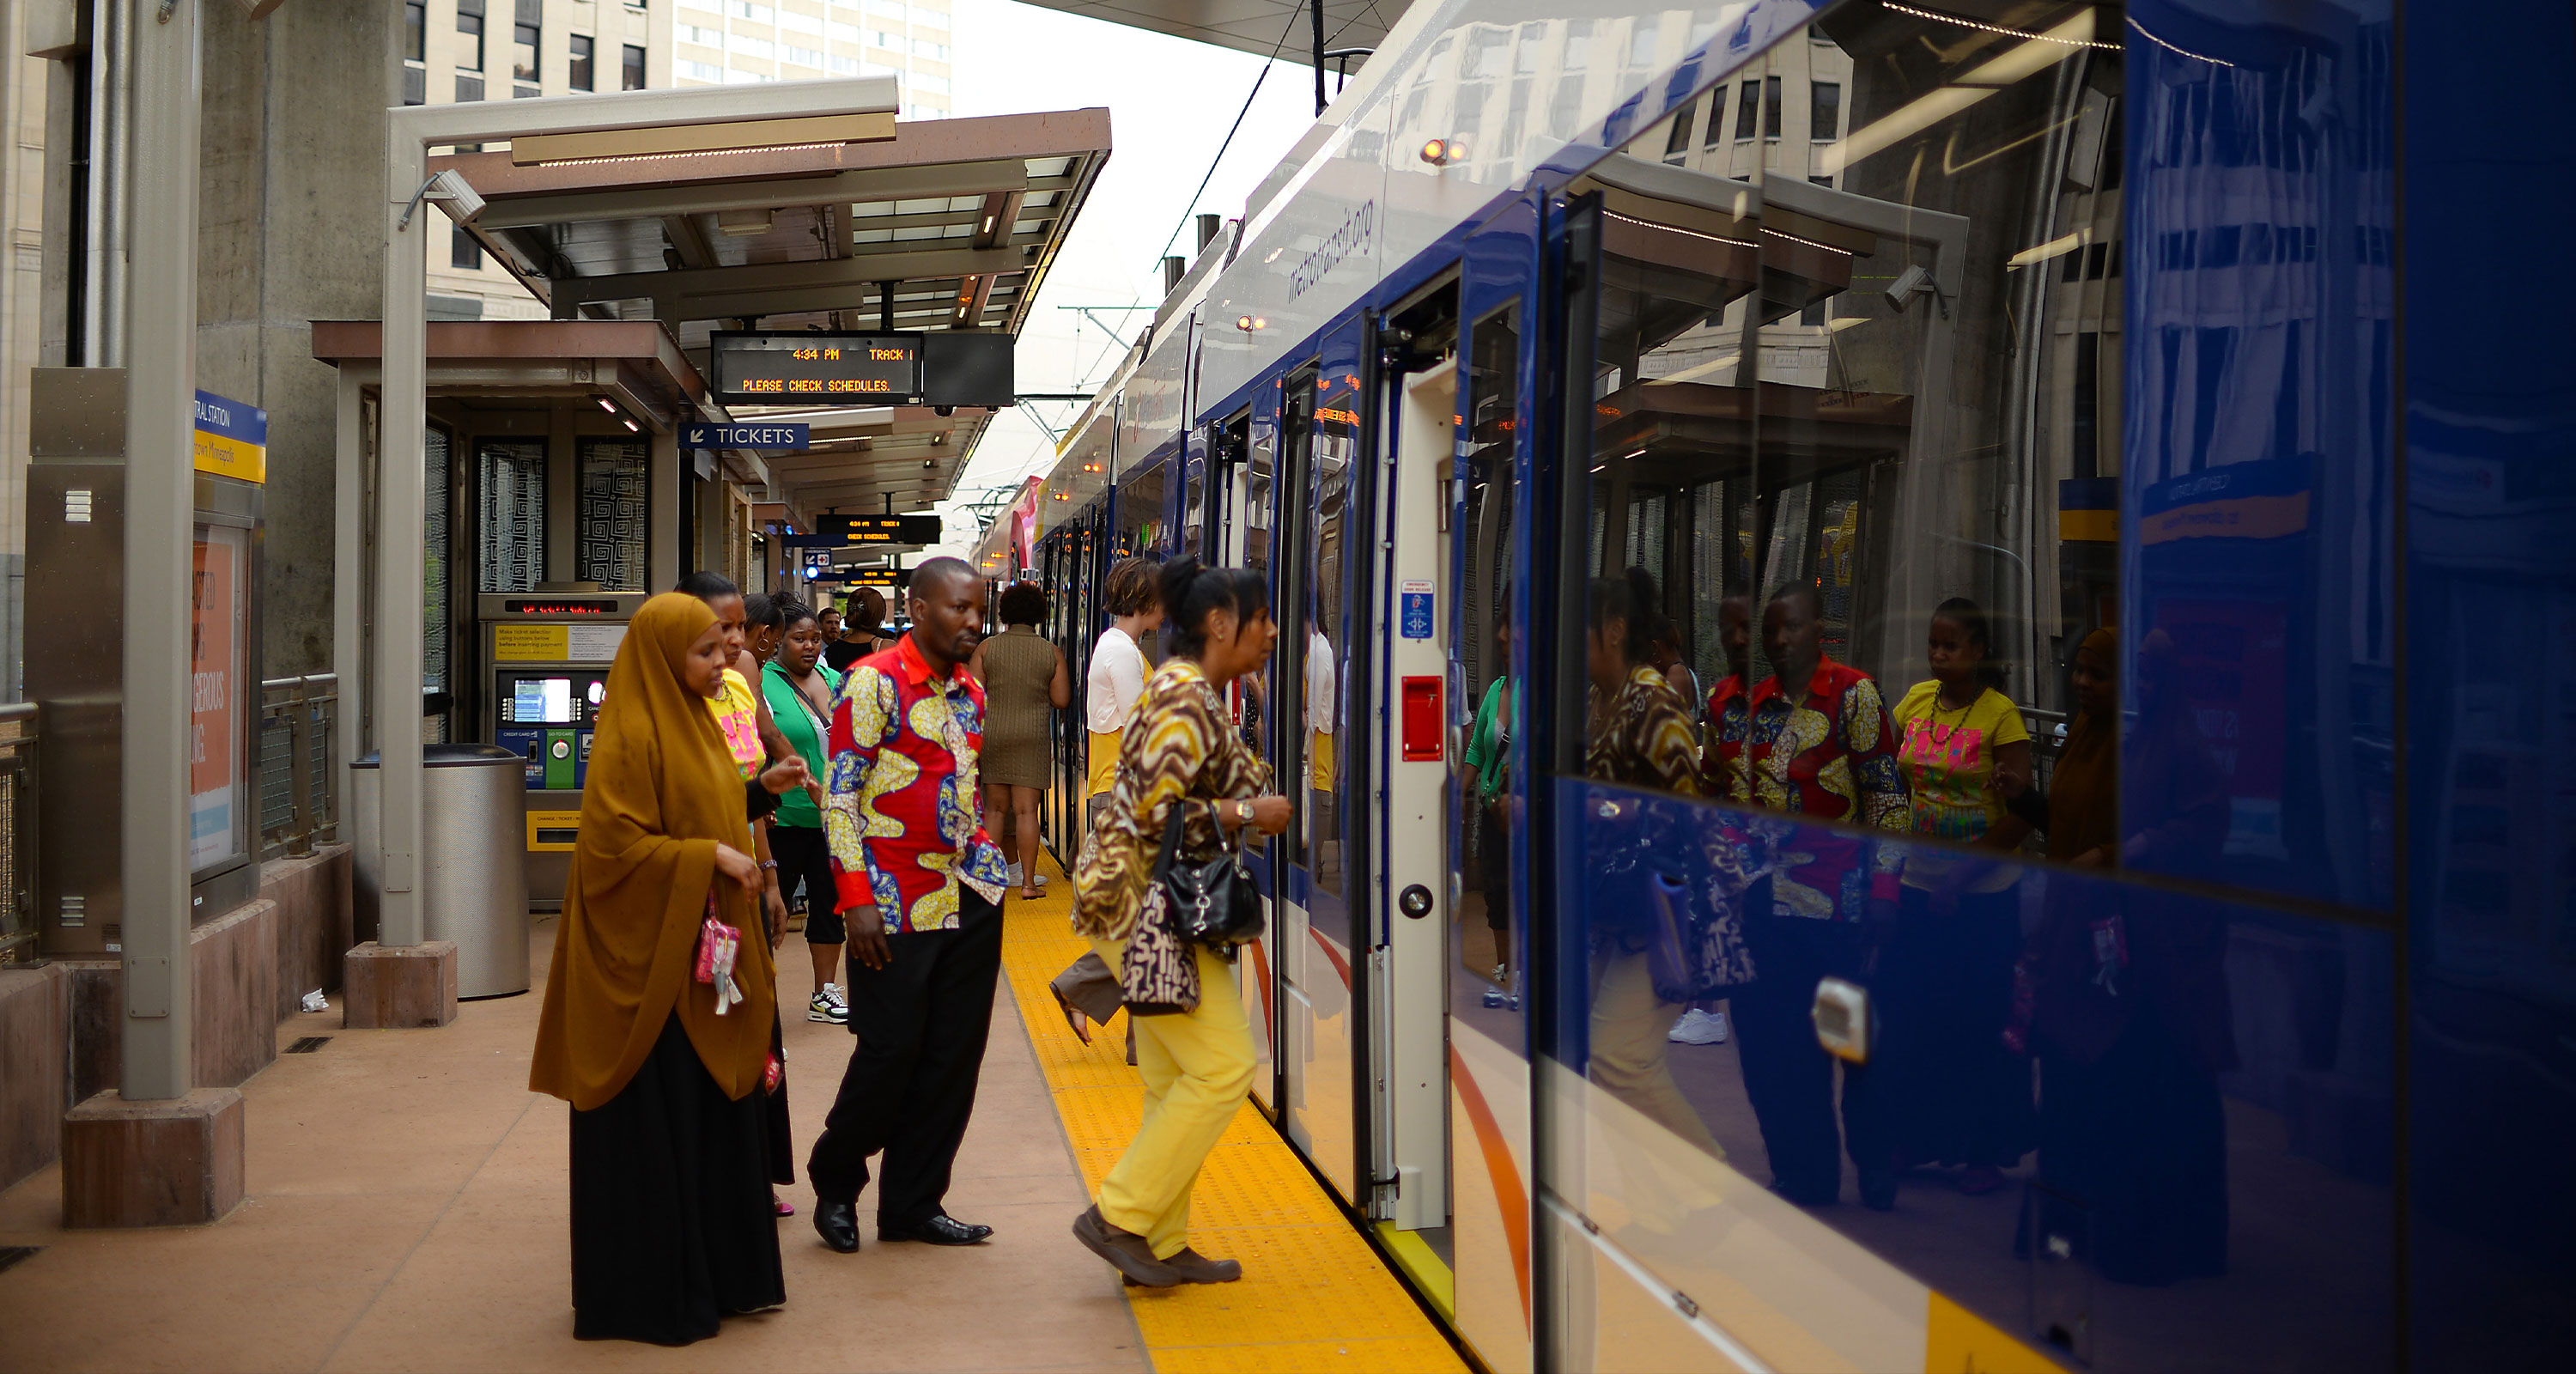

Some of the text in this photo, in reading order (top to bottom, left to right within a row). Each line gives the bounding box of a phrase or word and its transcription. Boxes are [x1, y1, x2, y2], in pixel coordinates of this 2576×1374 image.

[1288, 197, 1374, 305] metrotransit.org
[793, 348, 818, 361] 4:34
[823, 348, 841, 361] PM
[868, 348, 904, 361] TRACK
[743, 379, 890, 392] PLEASE CHECK SCHEDULES.
[194, 399, 230, 428] TRAL STATION
[715, 429, 794, 444] TICKETS
[191, 670, 224, 713] GEROUS
